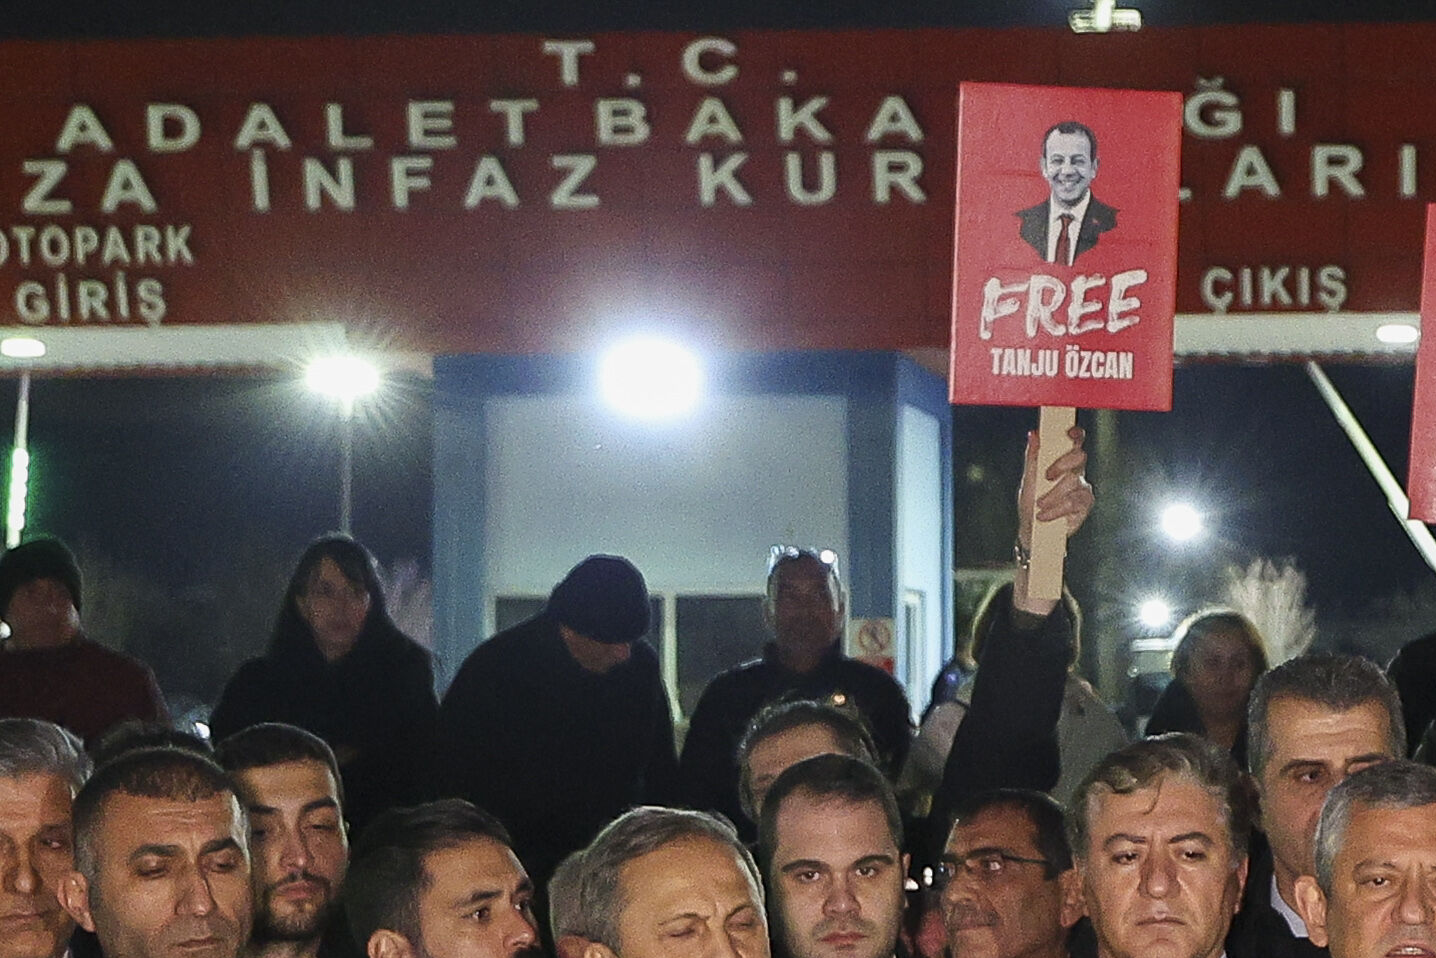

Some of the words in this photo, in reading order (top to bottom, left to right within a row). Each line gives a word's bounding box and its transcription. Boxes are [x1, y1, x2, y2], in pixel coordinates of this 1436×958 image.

[57, 99, 538, 153] ADALET
[596, 77, 1295, 147] BAKAĞI
[250, 147, 601, 212] İNFAZ
[699, 143, 1418, 206] KURARI
[15, 270, 167, 327] GİRİŞ
[979, 269, 1149, 340] FREE
[1202, 266, 1348, 312] ÇIKIŞ
[991, 347, 1060, 377] TANJU
[1065, 344, 1134, 380] ÖZCAN
